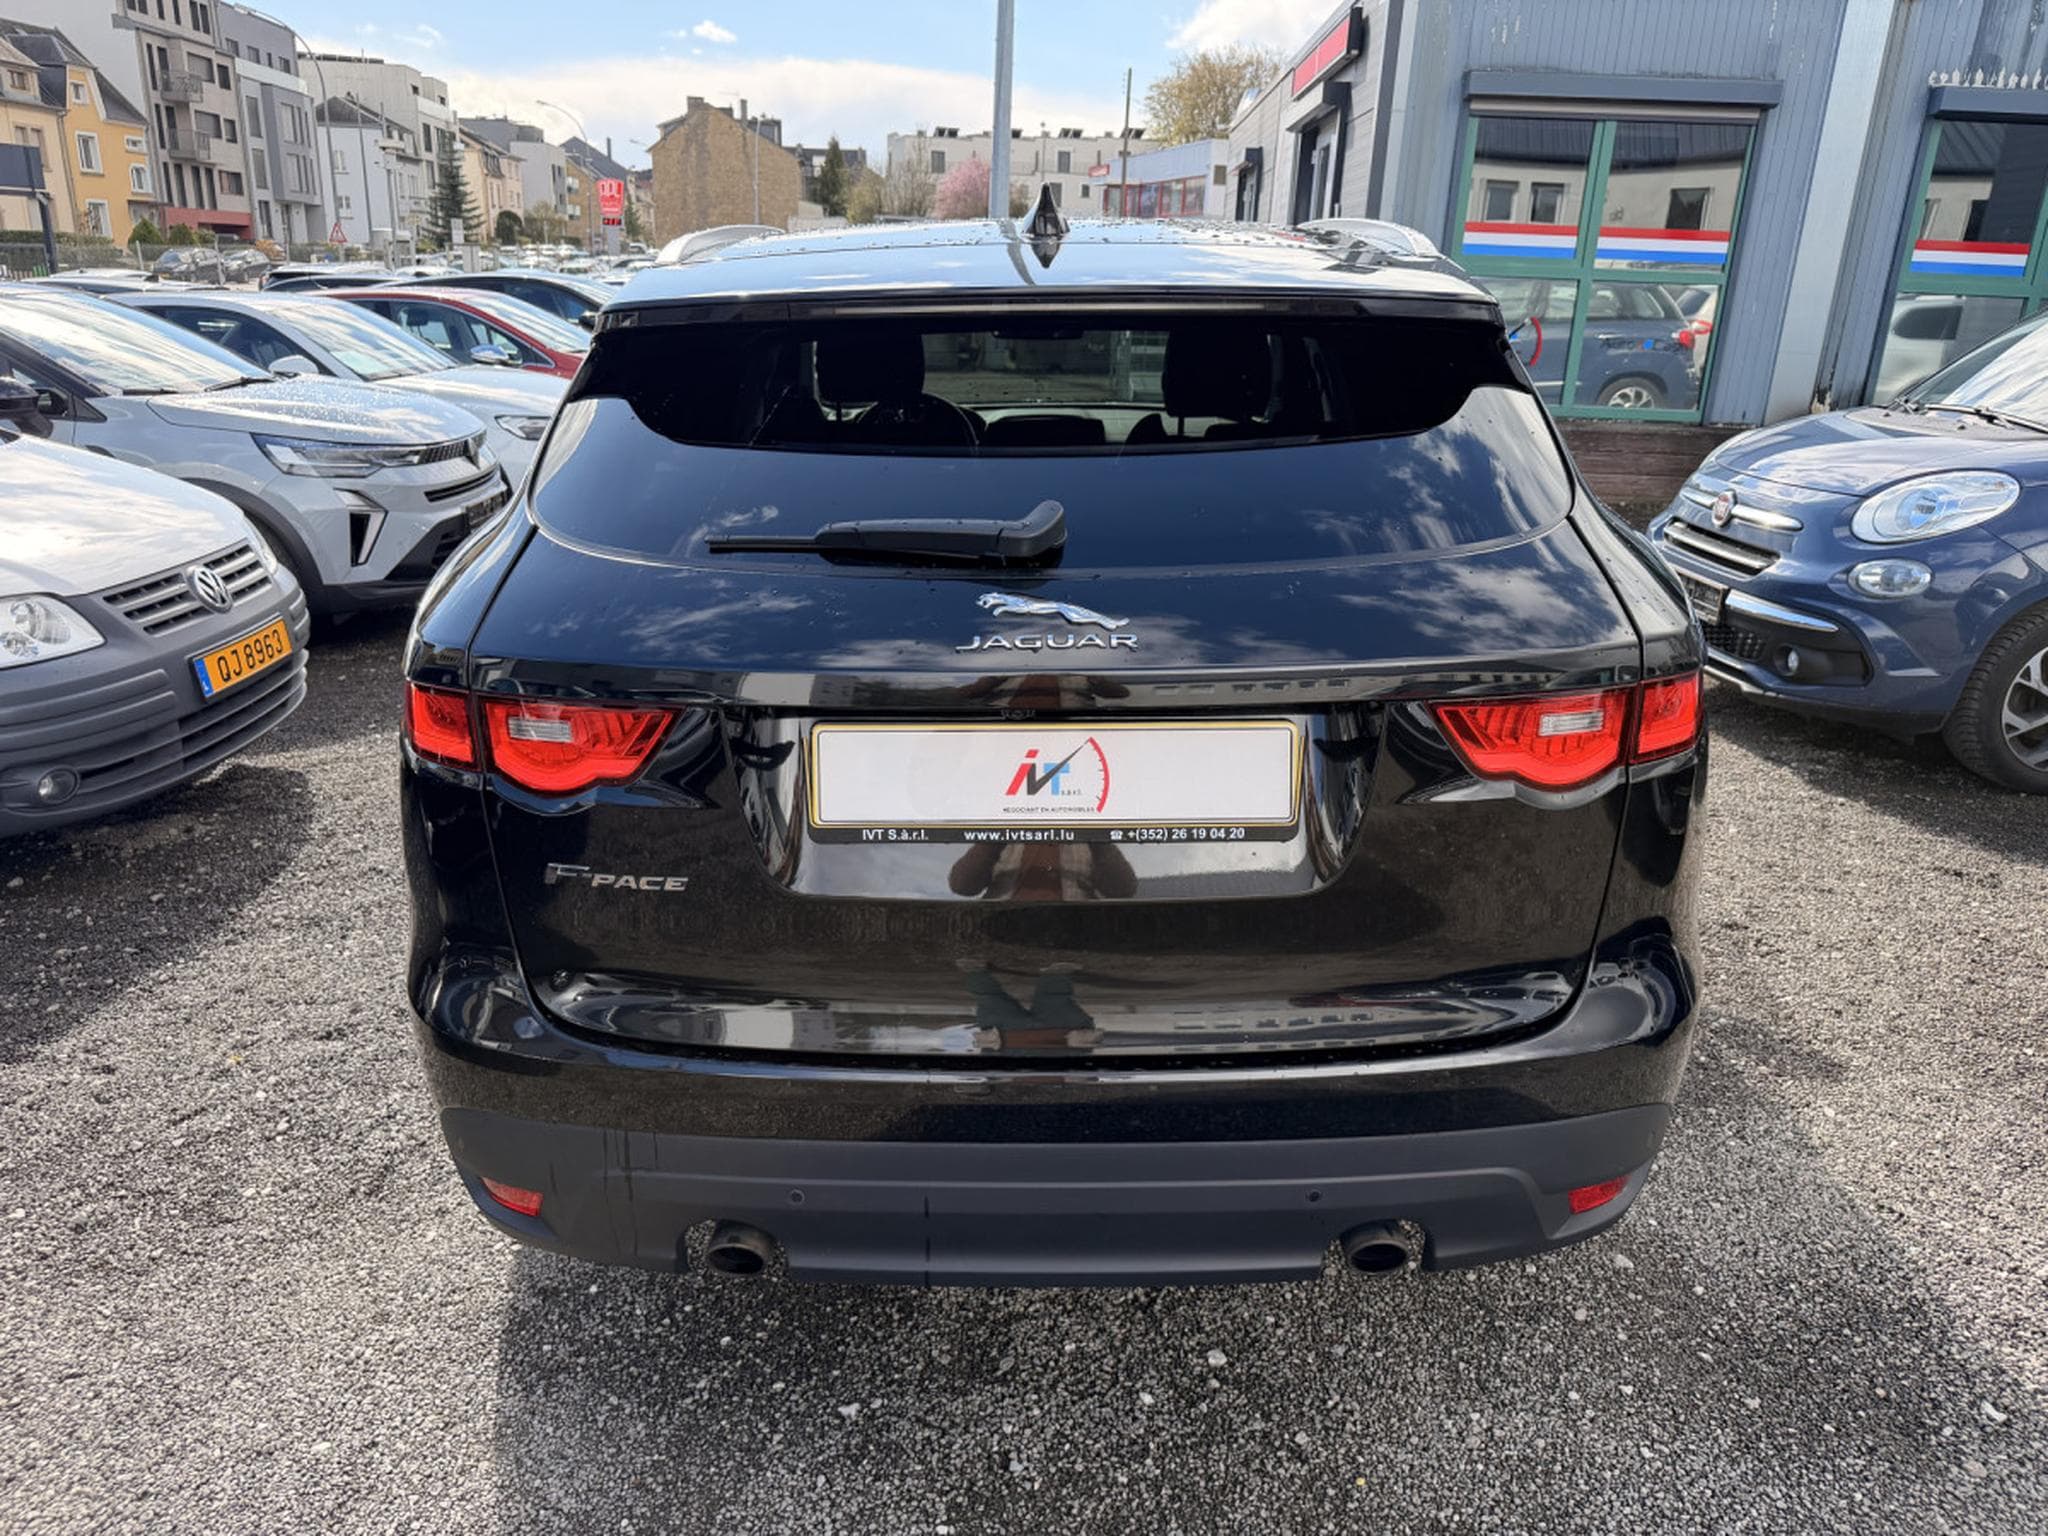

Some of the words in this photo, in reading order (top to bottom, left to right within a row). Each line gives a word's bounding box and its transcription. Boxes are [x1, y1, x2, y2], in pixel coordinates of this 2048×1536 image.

[955, 633, 1138, 650] JAGUAR
[862, 829, 884, 840] IVT
[887, 828, 929, 841] S.à.r.l.
[964, 828, 1074, 841] www.ivtsarl.lu
[1127, 828, 1168, 841] +(352)
[1172, 828, 1187, 840] 26
[1193, 828, 1206, 840] 19
[1210, 828, 1226, 840] 04
[1229, 827, 1245, 840] 20
[544, 862, 689, 891] F-PACE
